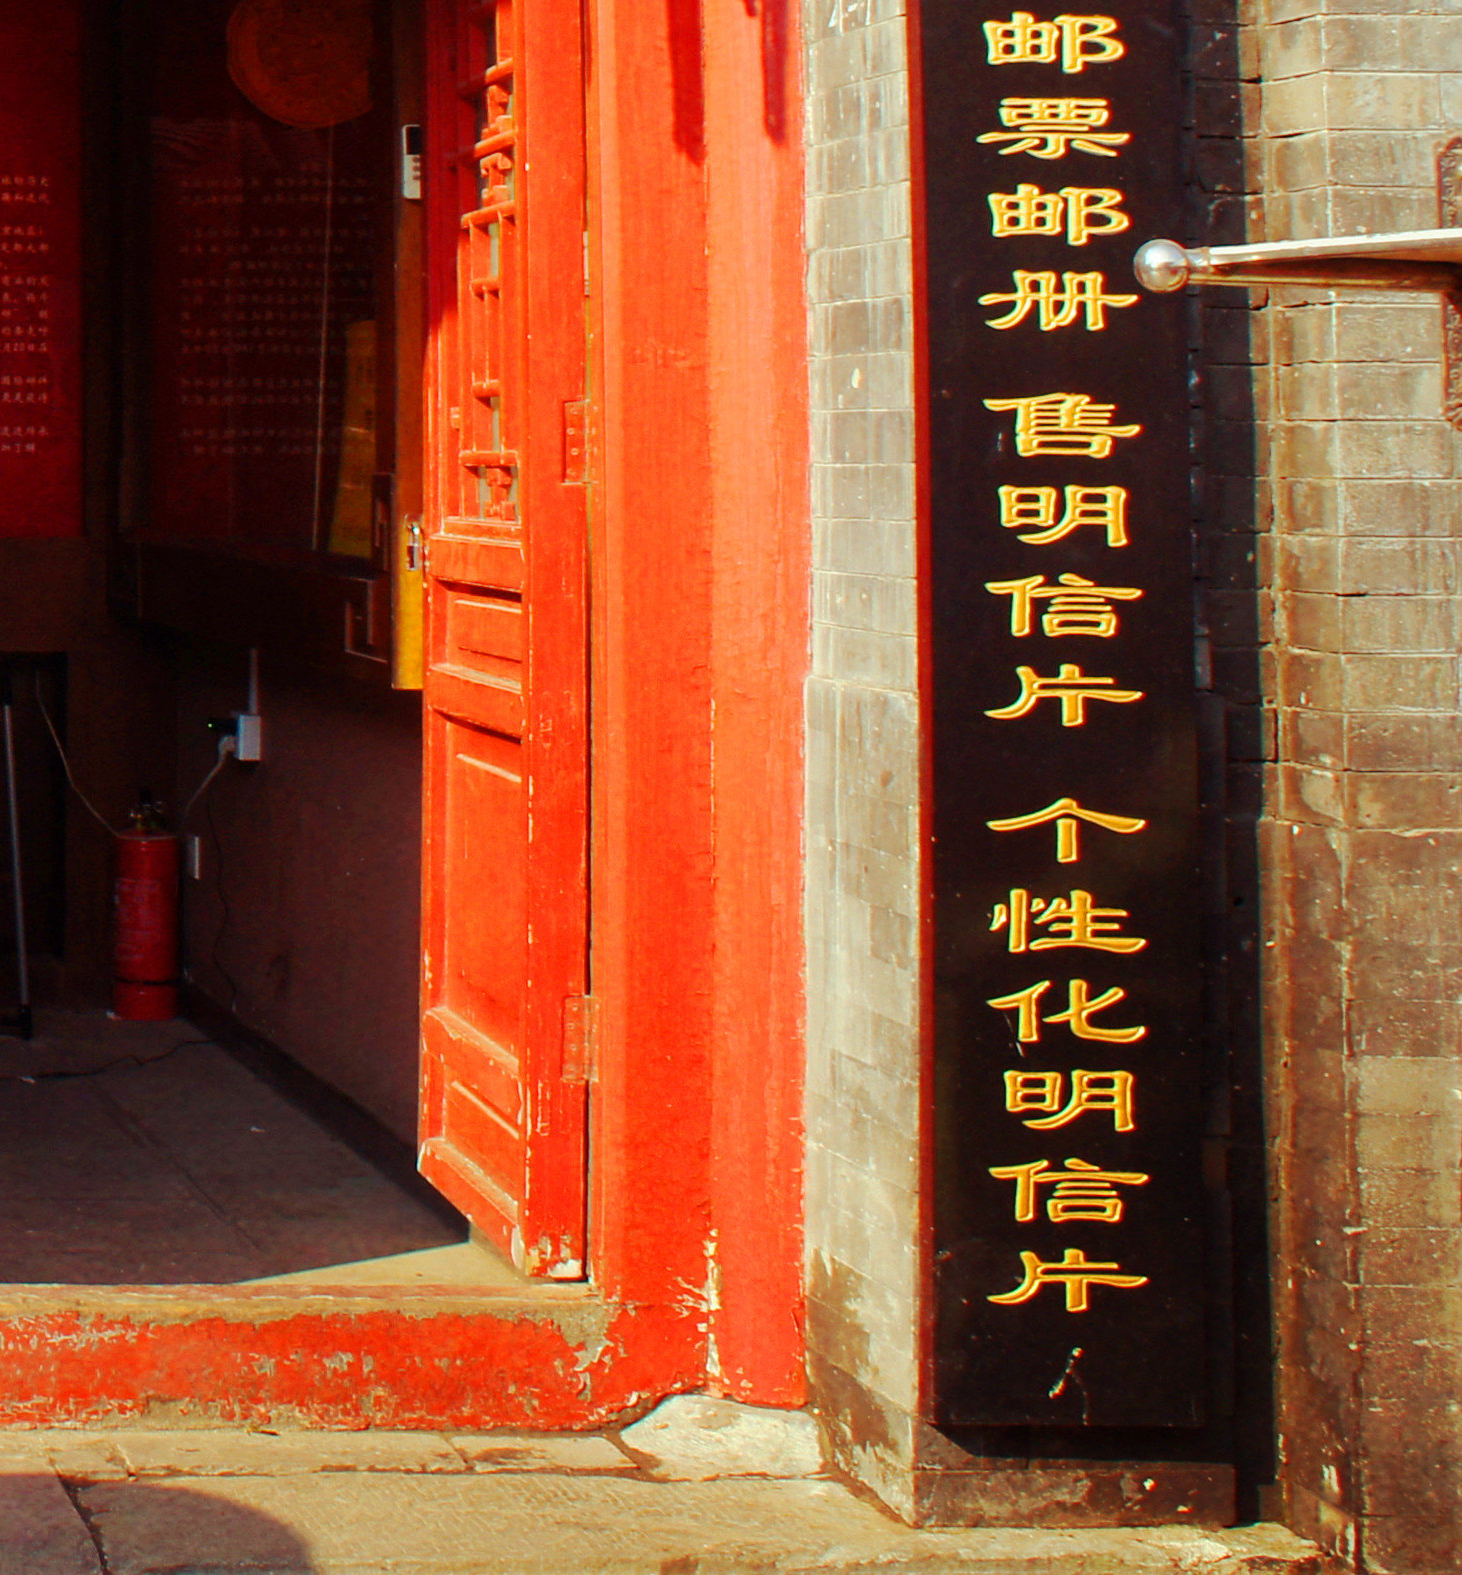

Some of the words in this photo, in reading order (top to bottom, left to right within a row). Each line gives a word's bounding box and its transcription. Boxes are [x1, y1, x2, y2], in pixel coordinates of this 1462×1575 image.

[977, 11, 1139, 332] 邮票邮册
[983, 392, 1142, 727] 售明信片
[987, 798, 1148, 1312] 个性化明信片
